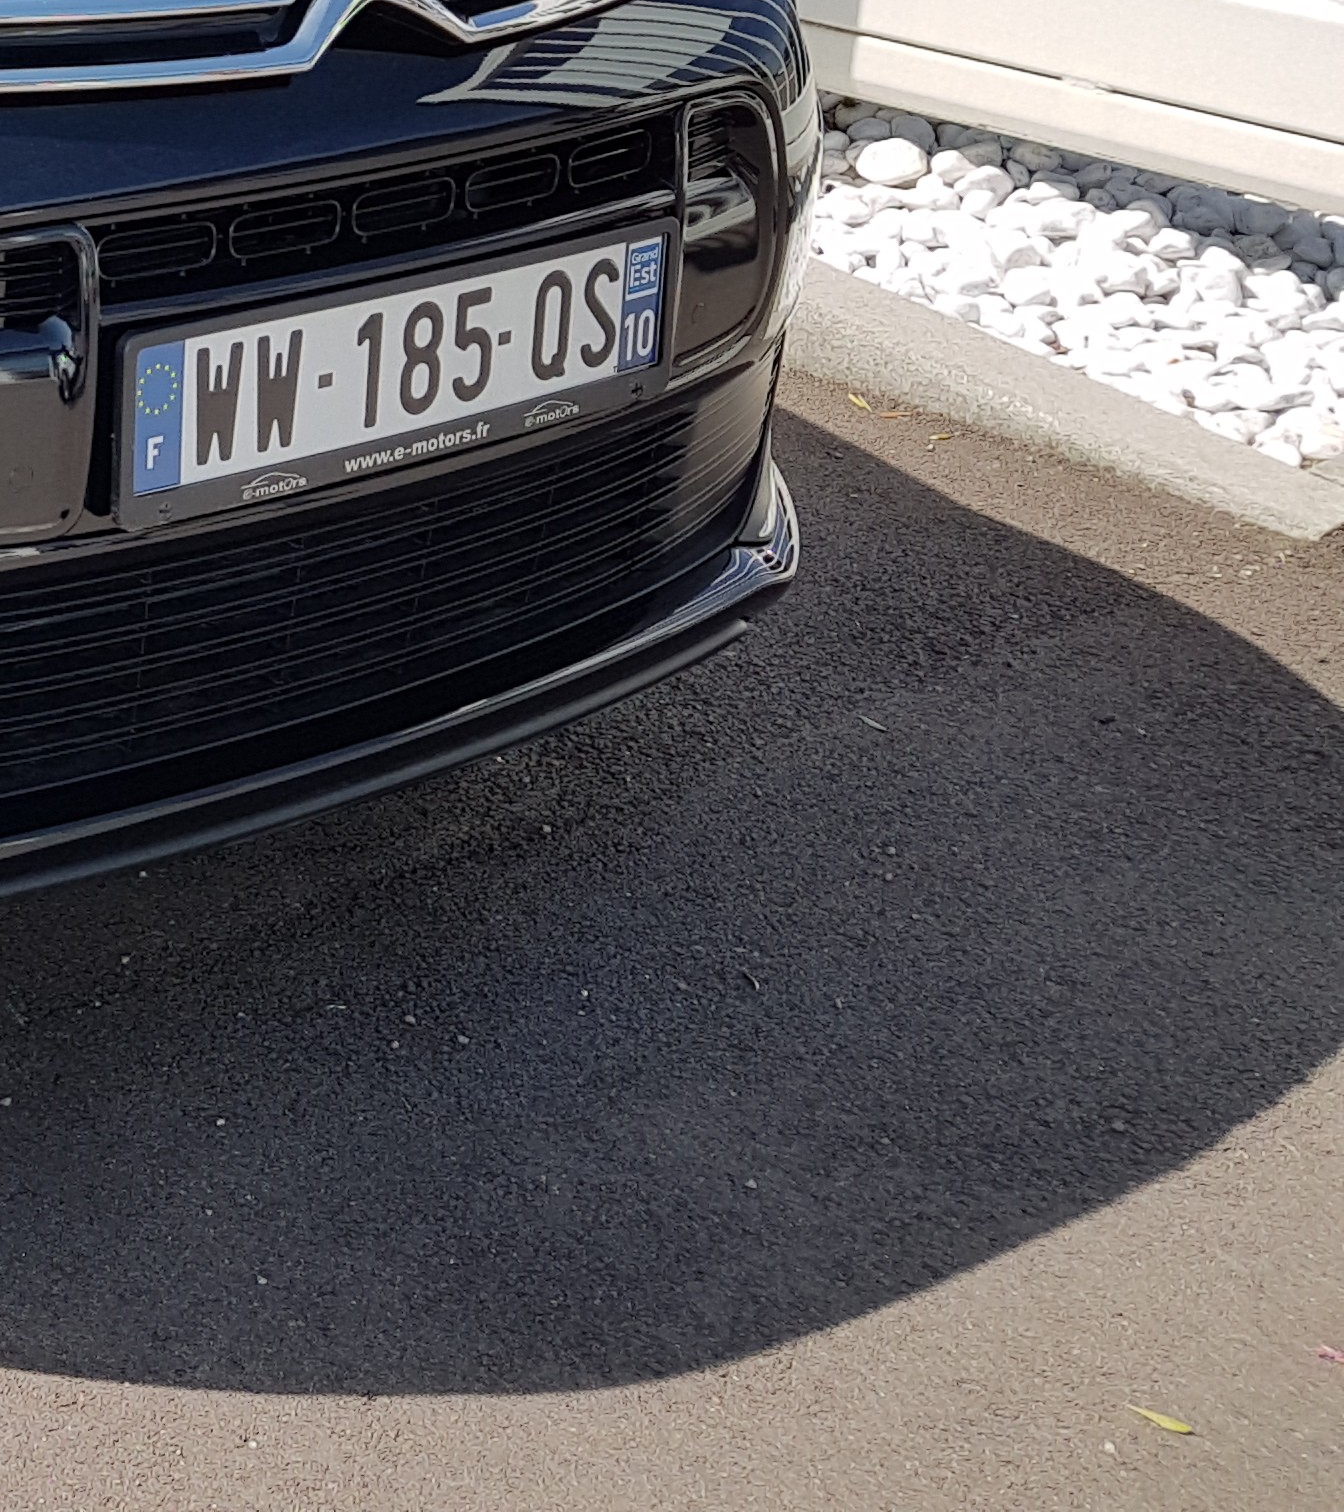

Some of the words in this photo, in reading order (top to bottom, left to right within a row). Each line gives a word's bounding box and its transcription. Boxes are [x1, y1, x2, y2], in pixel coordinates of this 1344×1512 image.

[631, 246, 658, 264] Grand
[629, 262, 657, 288] Est
[624, 308, 656, 361] 10
[146, 435, 163, 470] F
[344, 421, 490, 473] www.e-motors.fr
